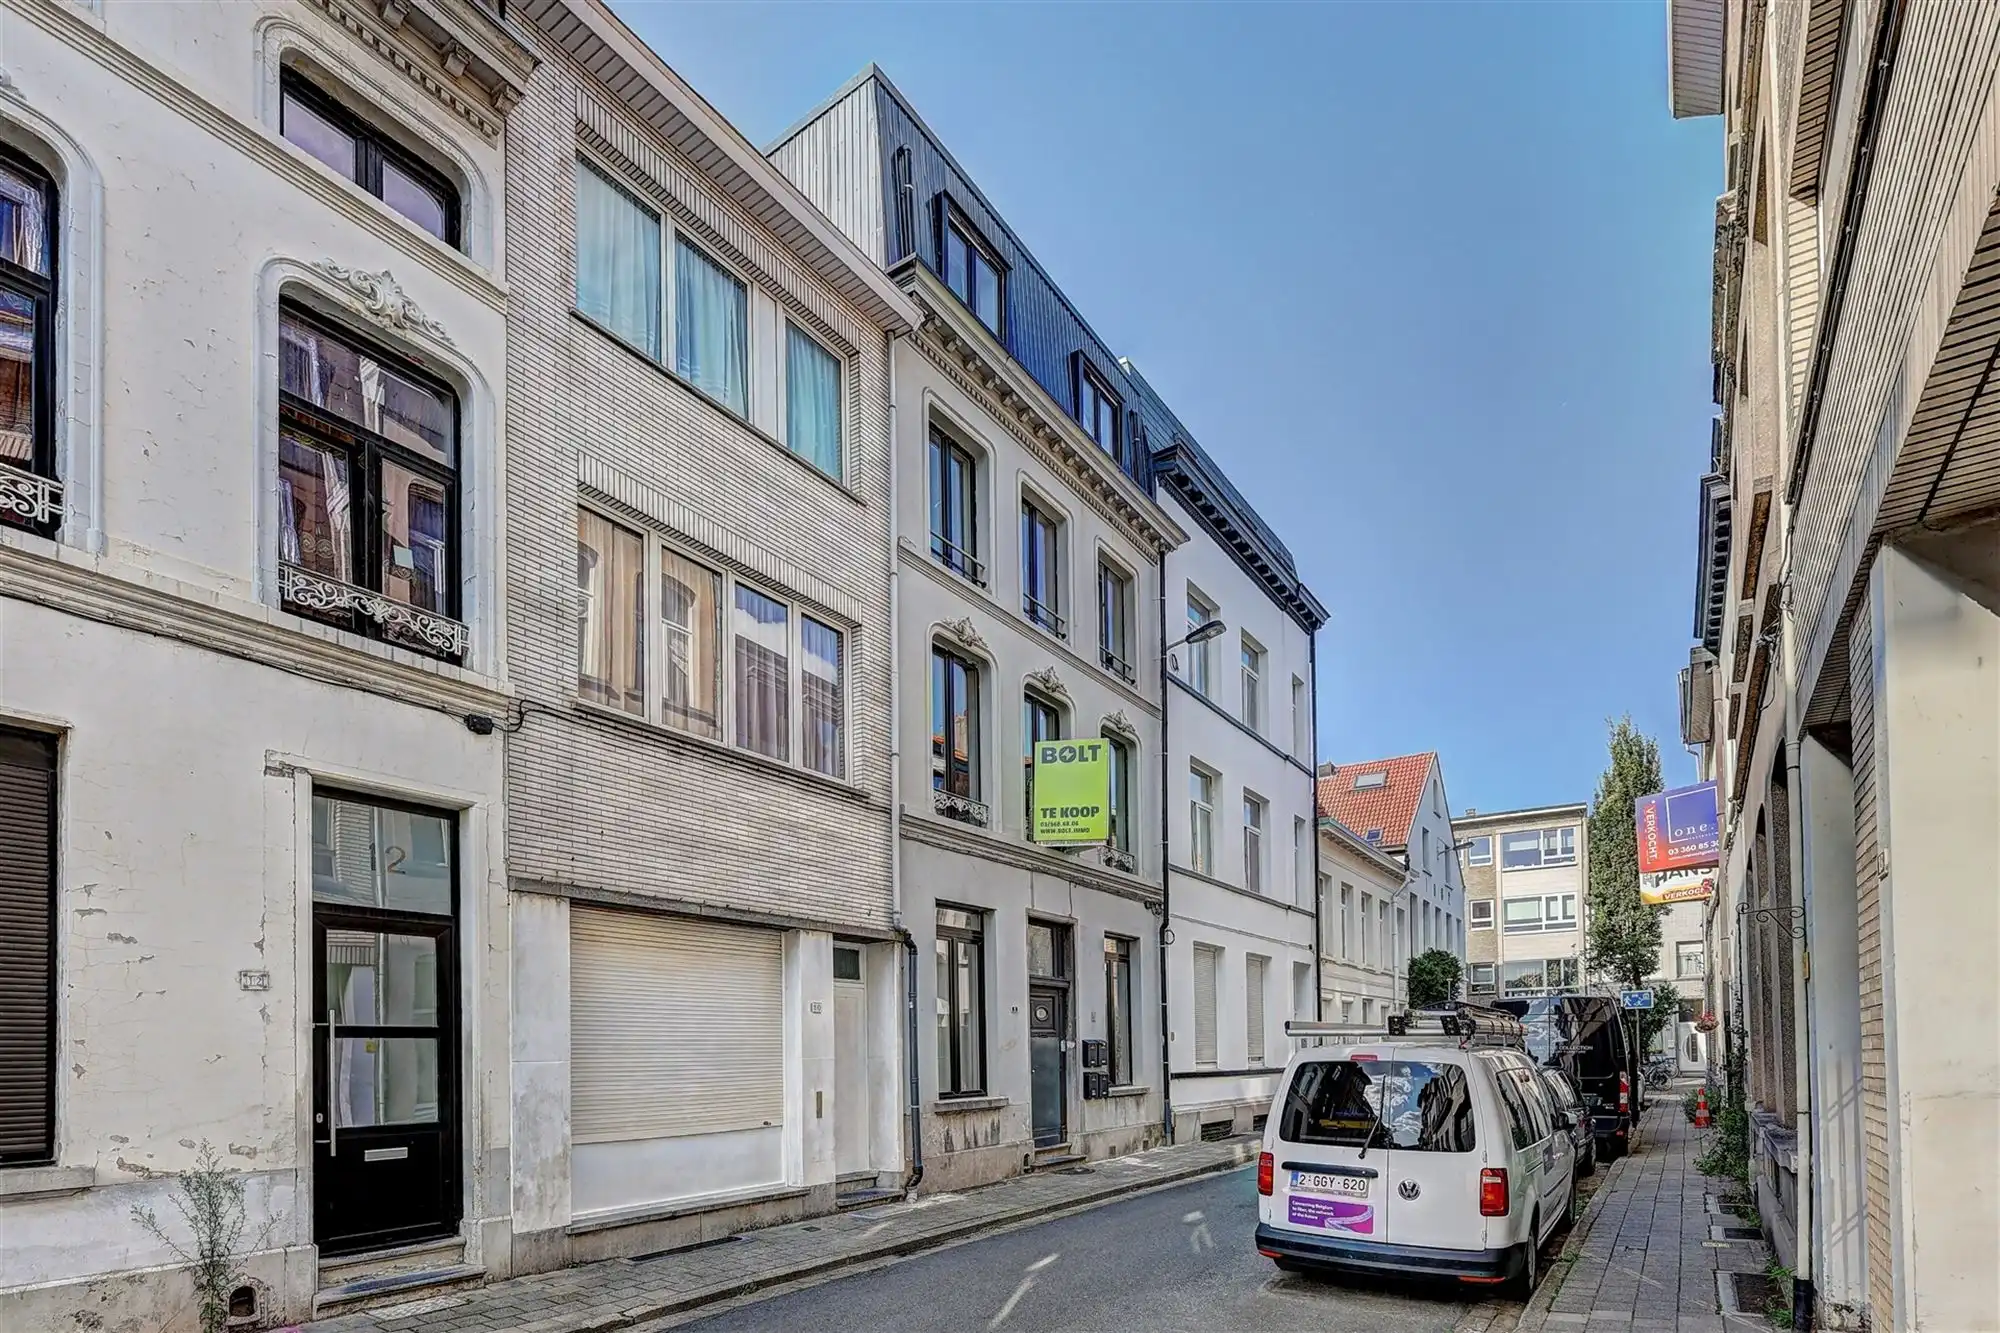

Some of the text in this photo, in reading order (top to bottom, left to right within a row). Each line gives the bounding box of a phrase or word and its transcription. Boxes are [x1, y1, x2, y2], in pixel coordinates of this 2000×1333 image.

[1041, 745, 1101, 764] BOLT
[1040, 806, 1100, 818] TE KOOP
[1646, 807, 1658, 859] VERKOCHT
[1668, 848, 1679, 856] 03
[1680, 844, 1697, 852] 360
[1664, 887, 1706, 899] VERKOC
